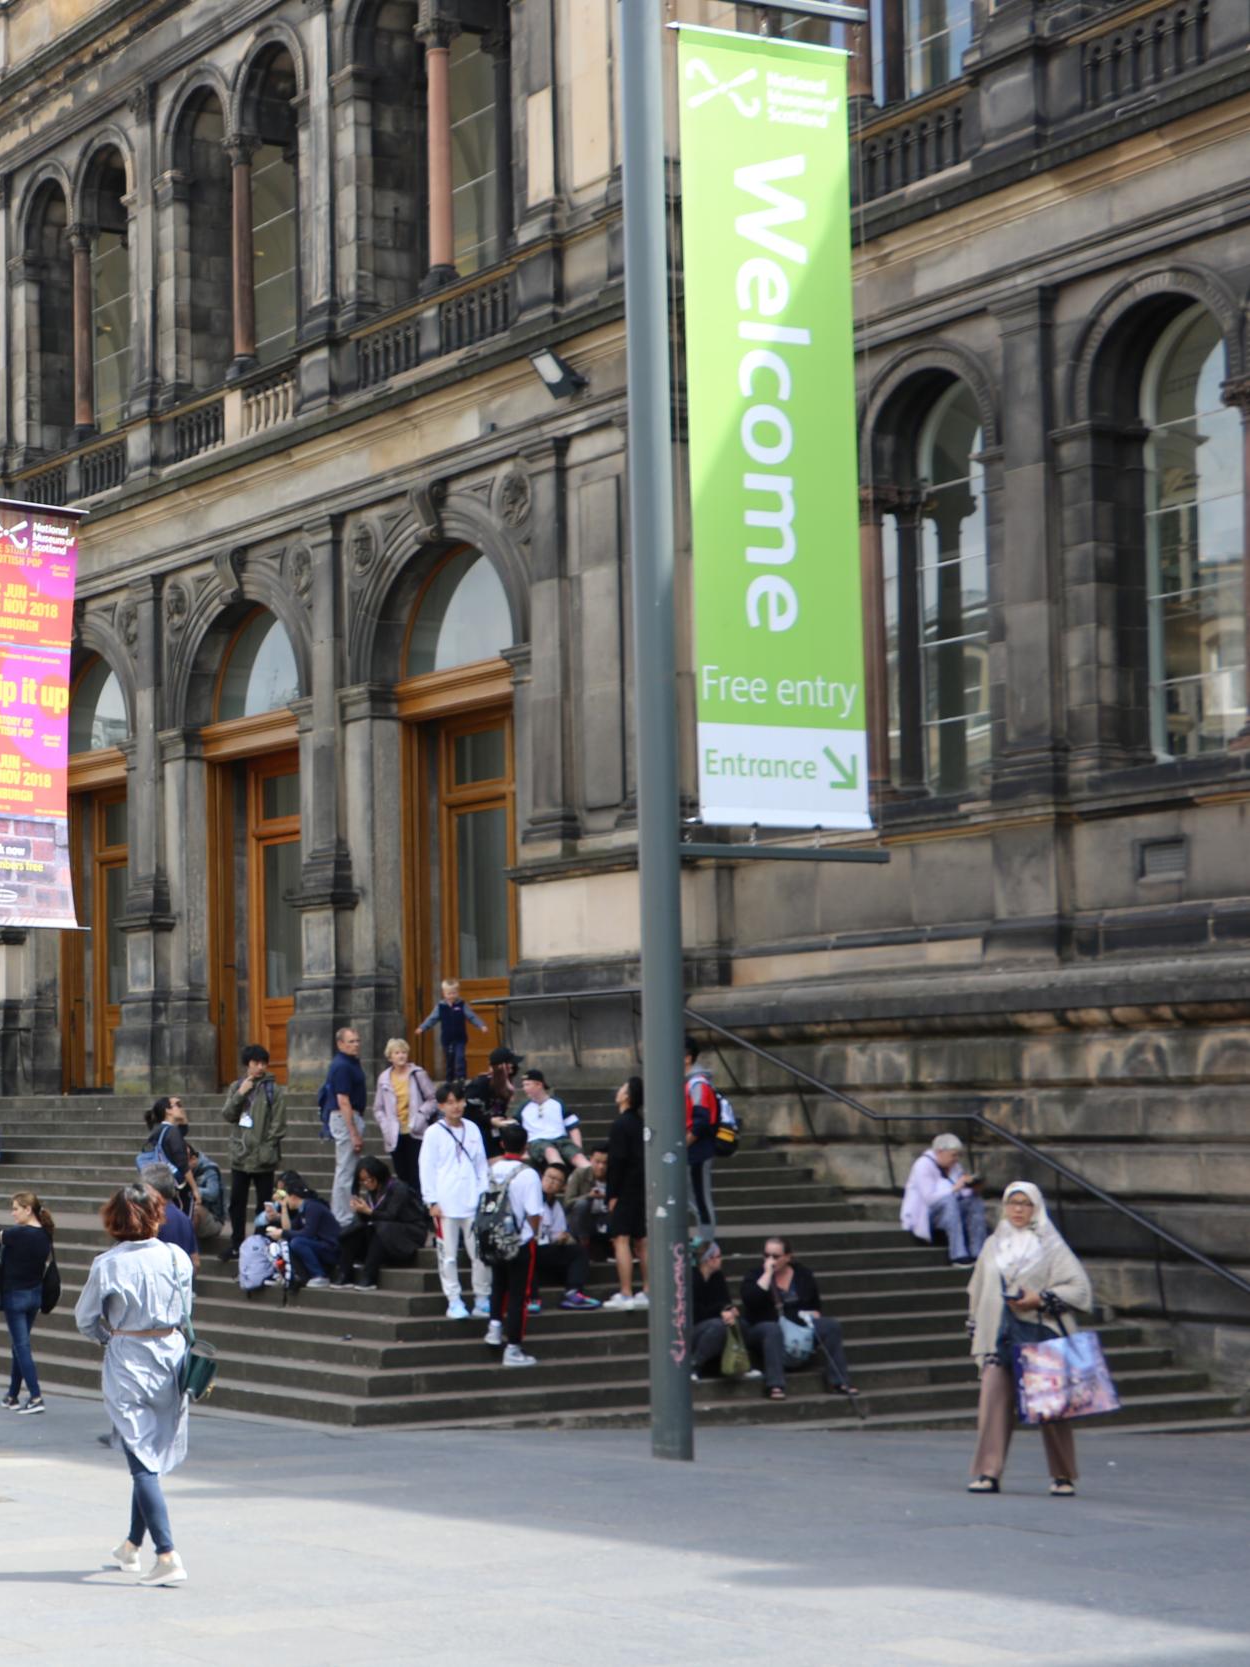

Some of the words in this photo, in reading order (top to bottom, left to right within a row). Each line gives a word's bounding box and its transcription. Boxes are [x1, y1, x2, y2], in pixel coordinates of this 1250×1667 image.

[766, 72, 827, 95] National
[766, 88, 824, 110] Museum
[767, 105, 828, 128] Scotland
[734, 154, 811, 632] Welcome
[33, 522, 69, 536] National
[32, 532, 66, 545] Museum
[66, 537, 75, 546] of
[32, 542, 67, 555] Scotland
[26, 558, 42, 568] POP
[3, 583, 28, 599] JUN
[3, 599, 28, 614] NOV
[30, 602, 58, 618] 2018
[22, 677, 37, 704] it
[40, 685, 69, 714] up
[702, 665, 766, 704] Free
[777, 675, 857, 718] entry
[23, 718, 33, 727] OF
[19, 728, 34, 738] POP
[704, 748, 818, 780] Entrance
[22, 771, 51, 788] 2018
[6, 846, 26, 856] now
[25, 860, 44, 872] free
